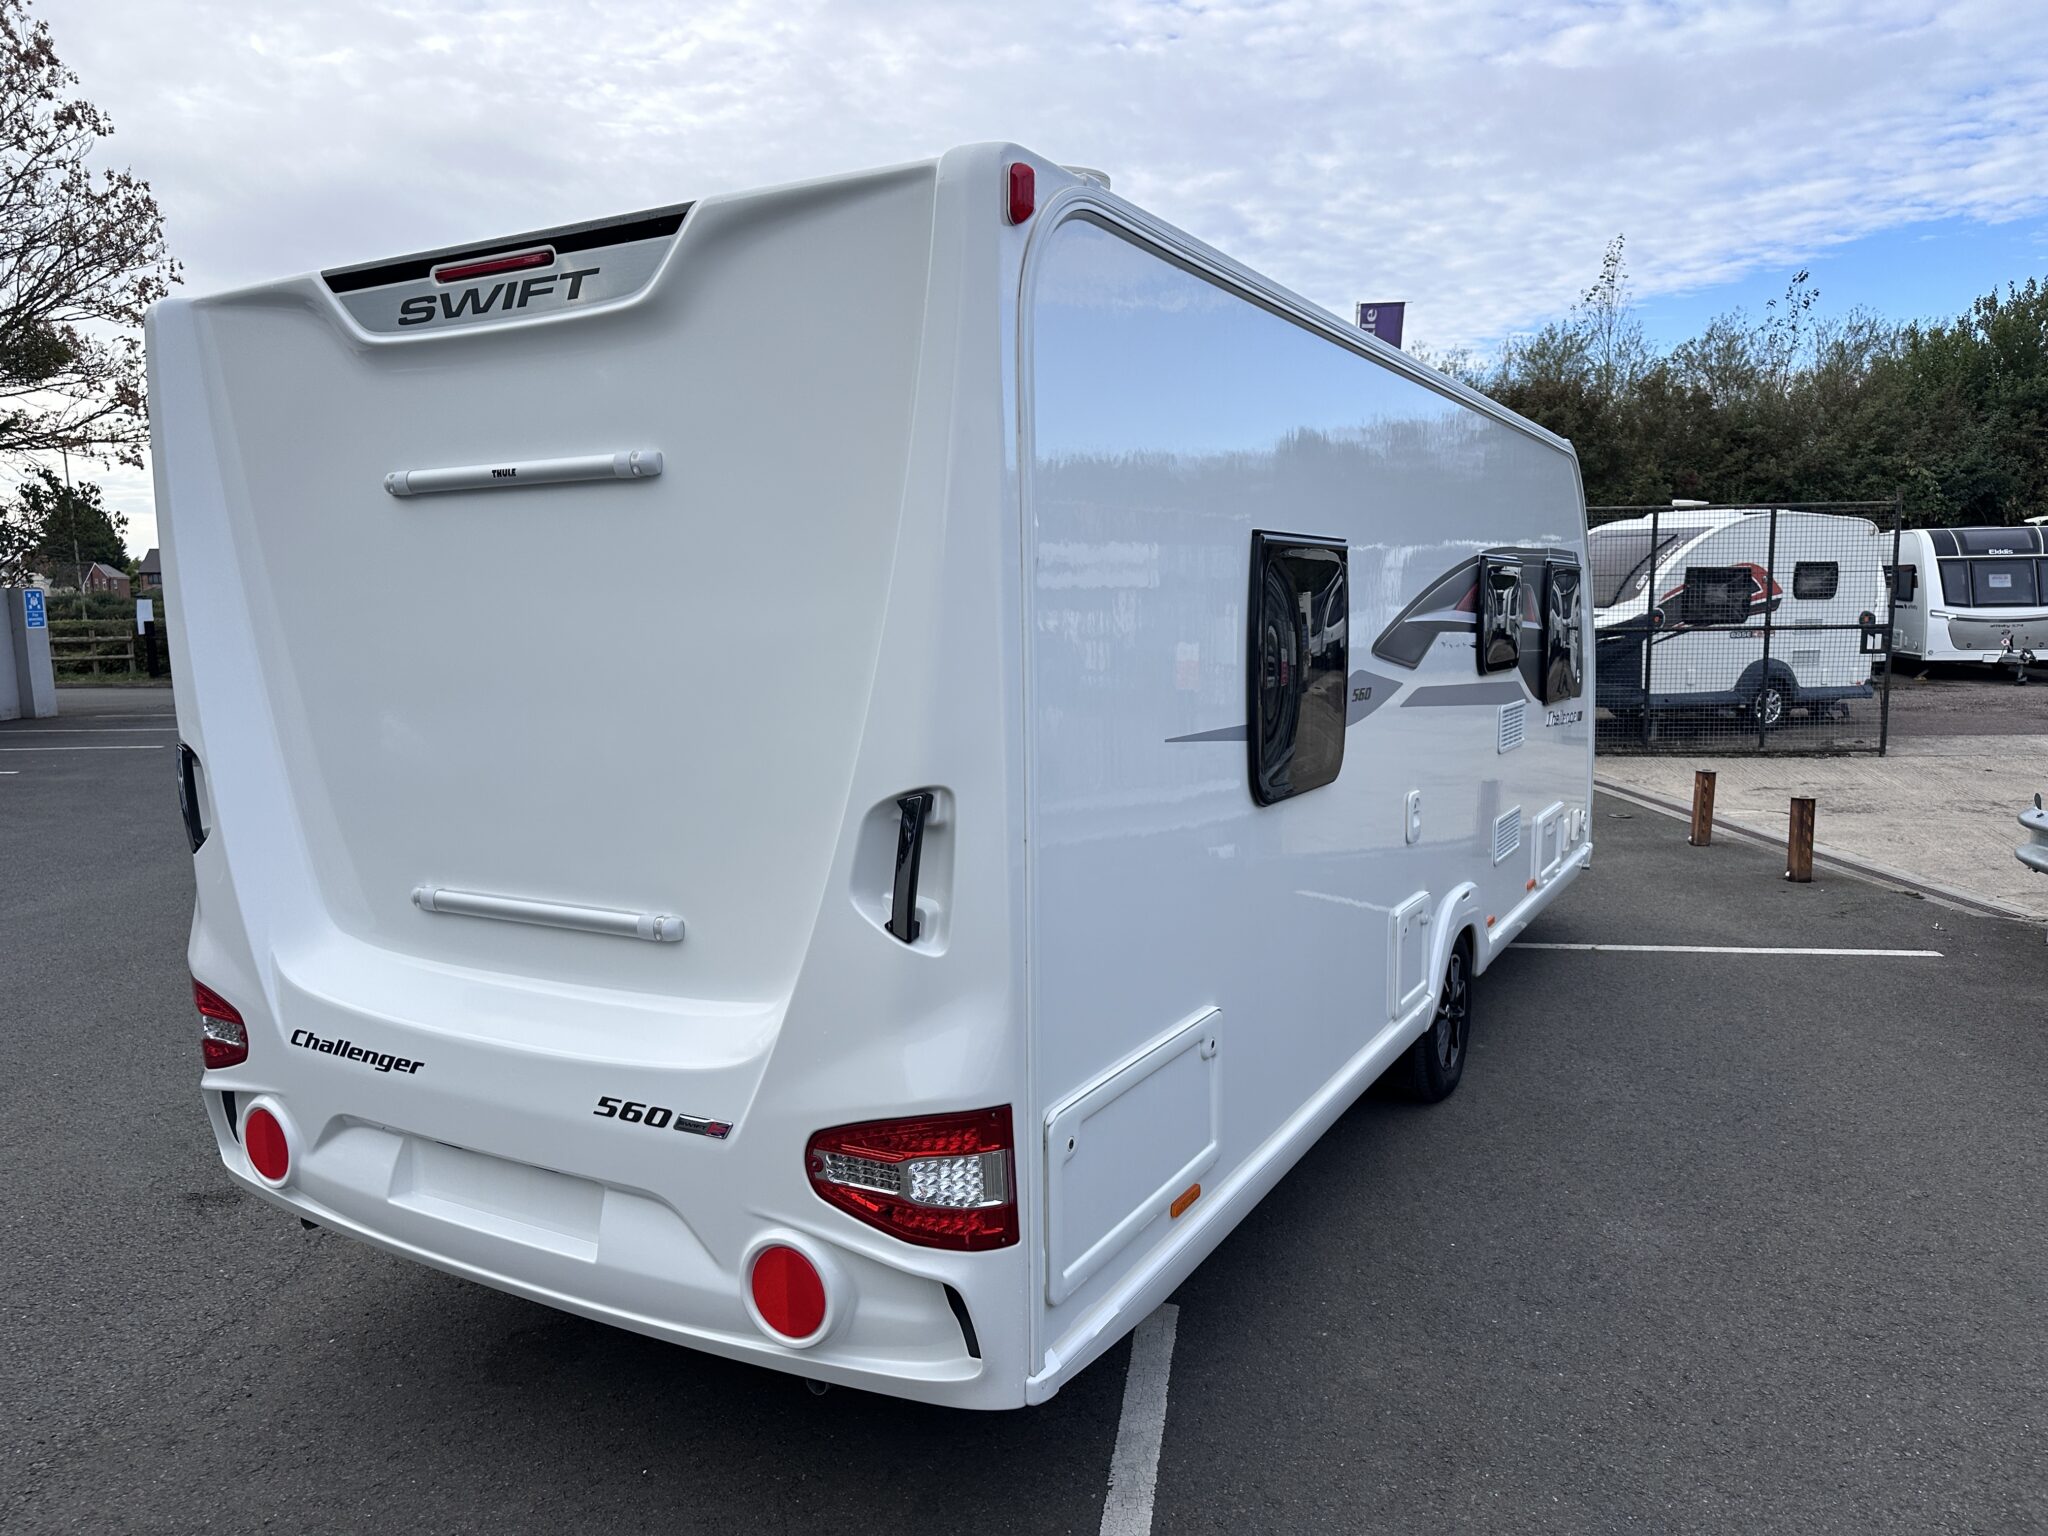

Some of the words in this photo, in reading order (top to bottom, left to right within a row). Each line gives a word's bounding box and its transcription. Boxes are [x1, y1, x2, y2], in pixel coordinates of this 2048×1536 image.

[398, 267, 600, 326] SWIFT
[491, 467, 517, 478] THULE
[1351, 686, 1372, 703] 560
[290, 1028, 425, 1075] Challenger
[592, 1095, 673, 1129] 560
